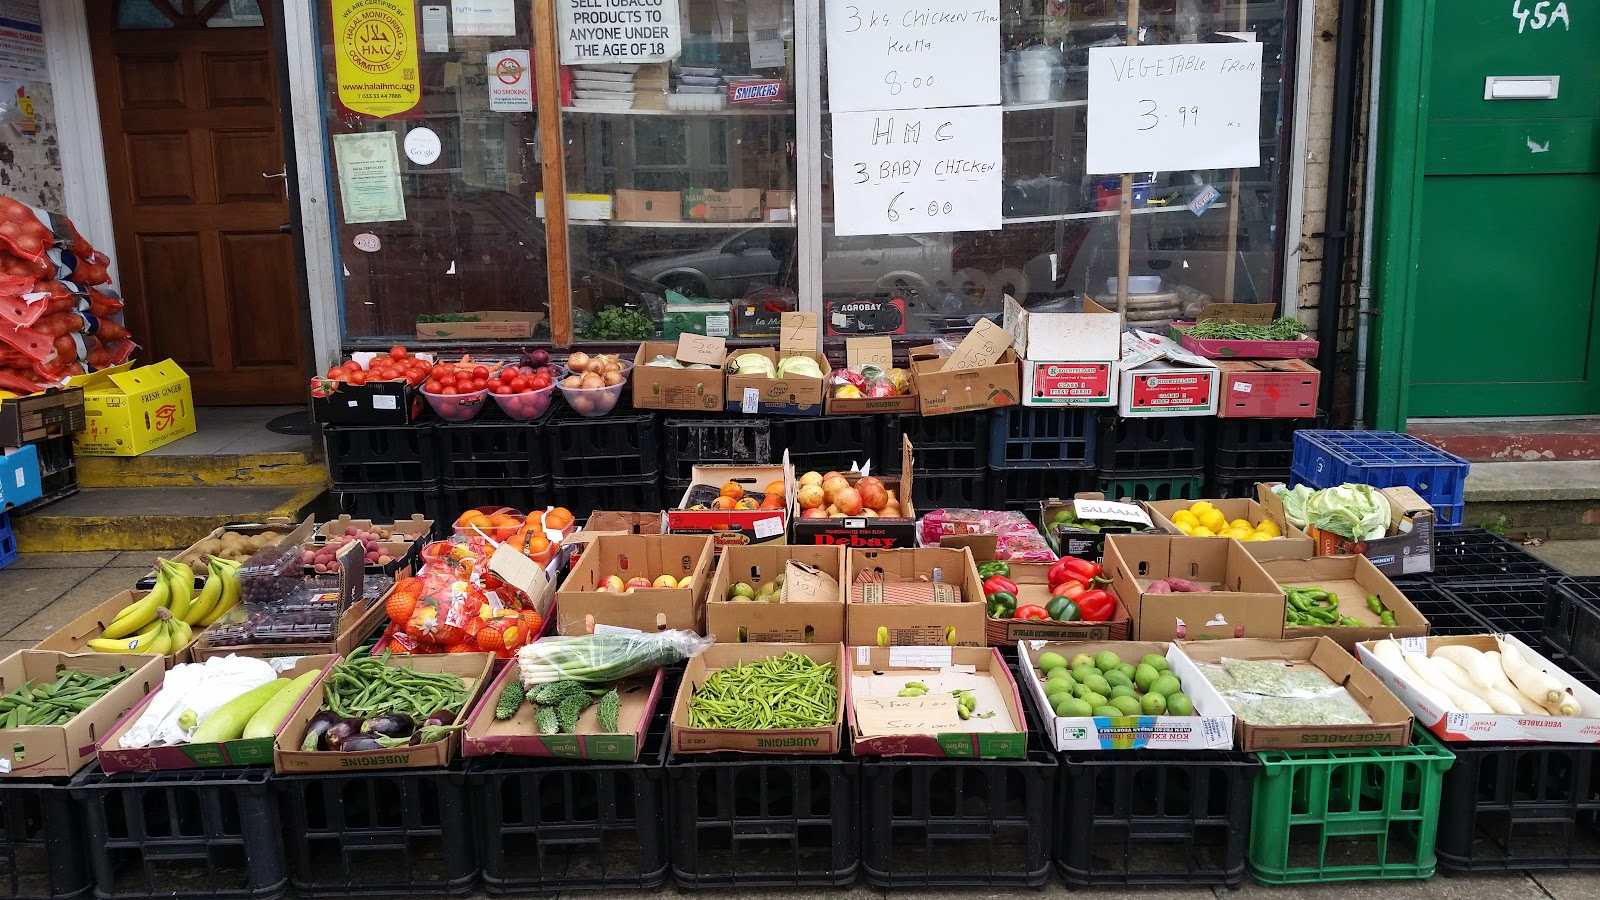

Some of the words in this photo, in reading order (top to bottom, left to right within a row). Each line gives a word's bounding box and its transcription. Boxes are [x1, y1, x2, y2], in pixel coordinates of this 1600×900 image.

[352, 1, 364, 11] ARE
[396, 7, 405, 17] BY
[572, 0, 602, 8] SELL
[574, 10, 642, 24] PRODUCTS
[644, 10, 662, 22] TO
[846, 6, 862, 32] 3
[1512, 0, 1570, 34] 45A
[346, 18, 363, 40] HALAL
[361, 11, 404, 39] MONITORING
[570, 28, 622, 40] ANYONE
[624, 26, 670, 39] UNDER
[362, 45, 391, 54] HMC
[575, 44, 600, 56] THE
[602, 44, 628, 56] AGE
[630, 44, 646, 55] OF
[650, 42, 664, 54] 18
[349, 50, 392, 72] COMMITTEE
[394, 50, 404, 61] UK
[342, 83, 415, 92] www.halalhmc.org
[736, 84, 779, 99] SNICKERS
[410, 148, 434, 158] Google
[854, 162, 870, 184] 3
[880, 160, 922, 178] BABY
[934, 160, 996, 176] CHICKEN
[842, 304, 882, 312] AGROBAY
[790, 314, 804, 340] 2
[976, 322, 992, 338] 2
[141, 391, 160, 404] FRESH
[162, 384, 182, 397] GINGER
[924, 396, 946, 405] Tropical
[1082, 506, 1140, 518] SALAAM
[814, 534, 897, 549] Debay
[1518, 720, 1562, 728] VEGETABLES
[757, 738, 820, 747] AUBERGINE
[1301, 733, 1392, 743] VEGETABLES
[341, 754, 410, 767] AUBERGINE
